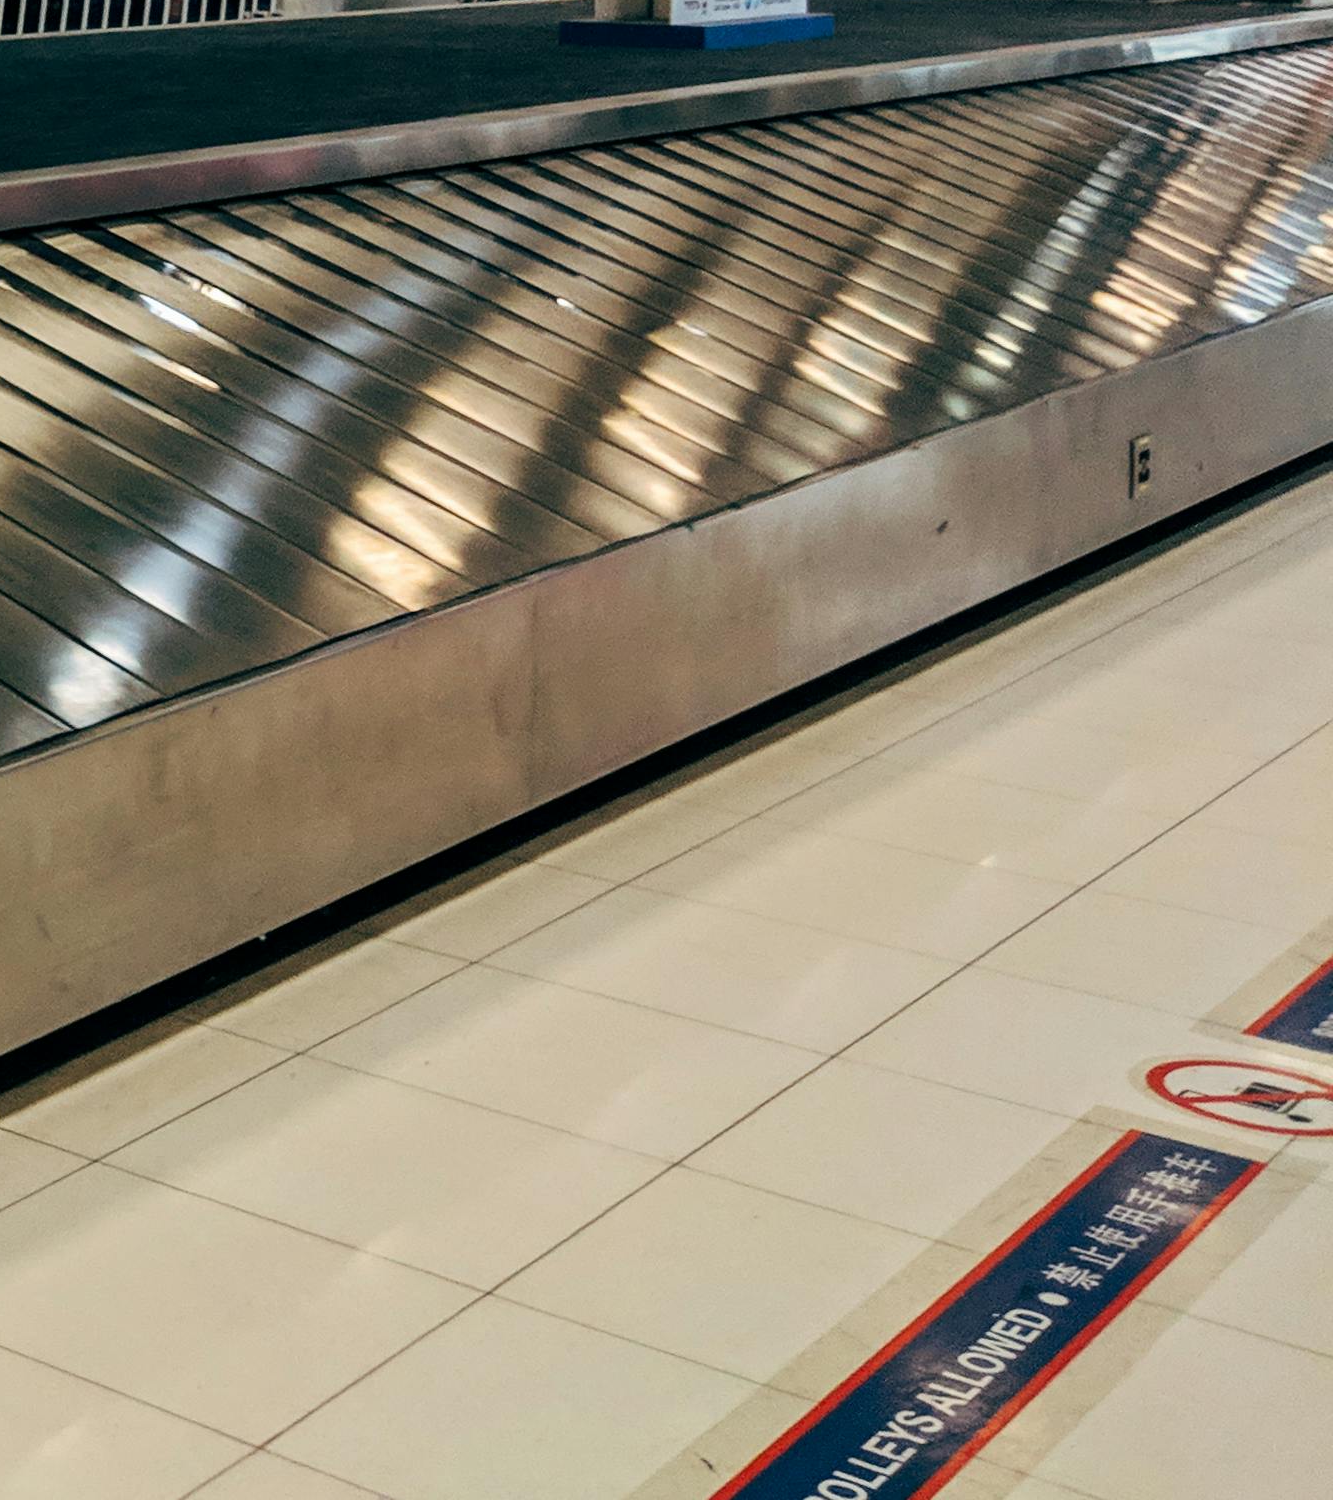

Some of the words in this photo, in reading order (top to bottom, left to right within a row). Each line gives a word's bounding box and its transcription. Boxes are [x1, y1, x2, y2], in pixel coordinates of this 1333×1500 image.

[1040, 1152, 1218, 1291] 禁止使用手推车
[915, 1307, 1053, 1416] ALLOWED
